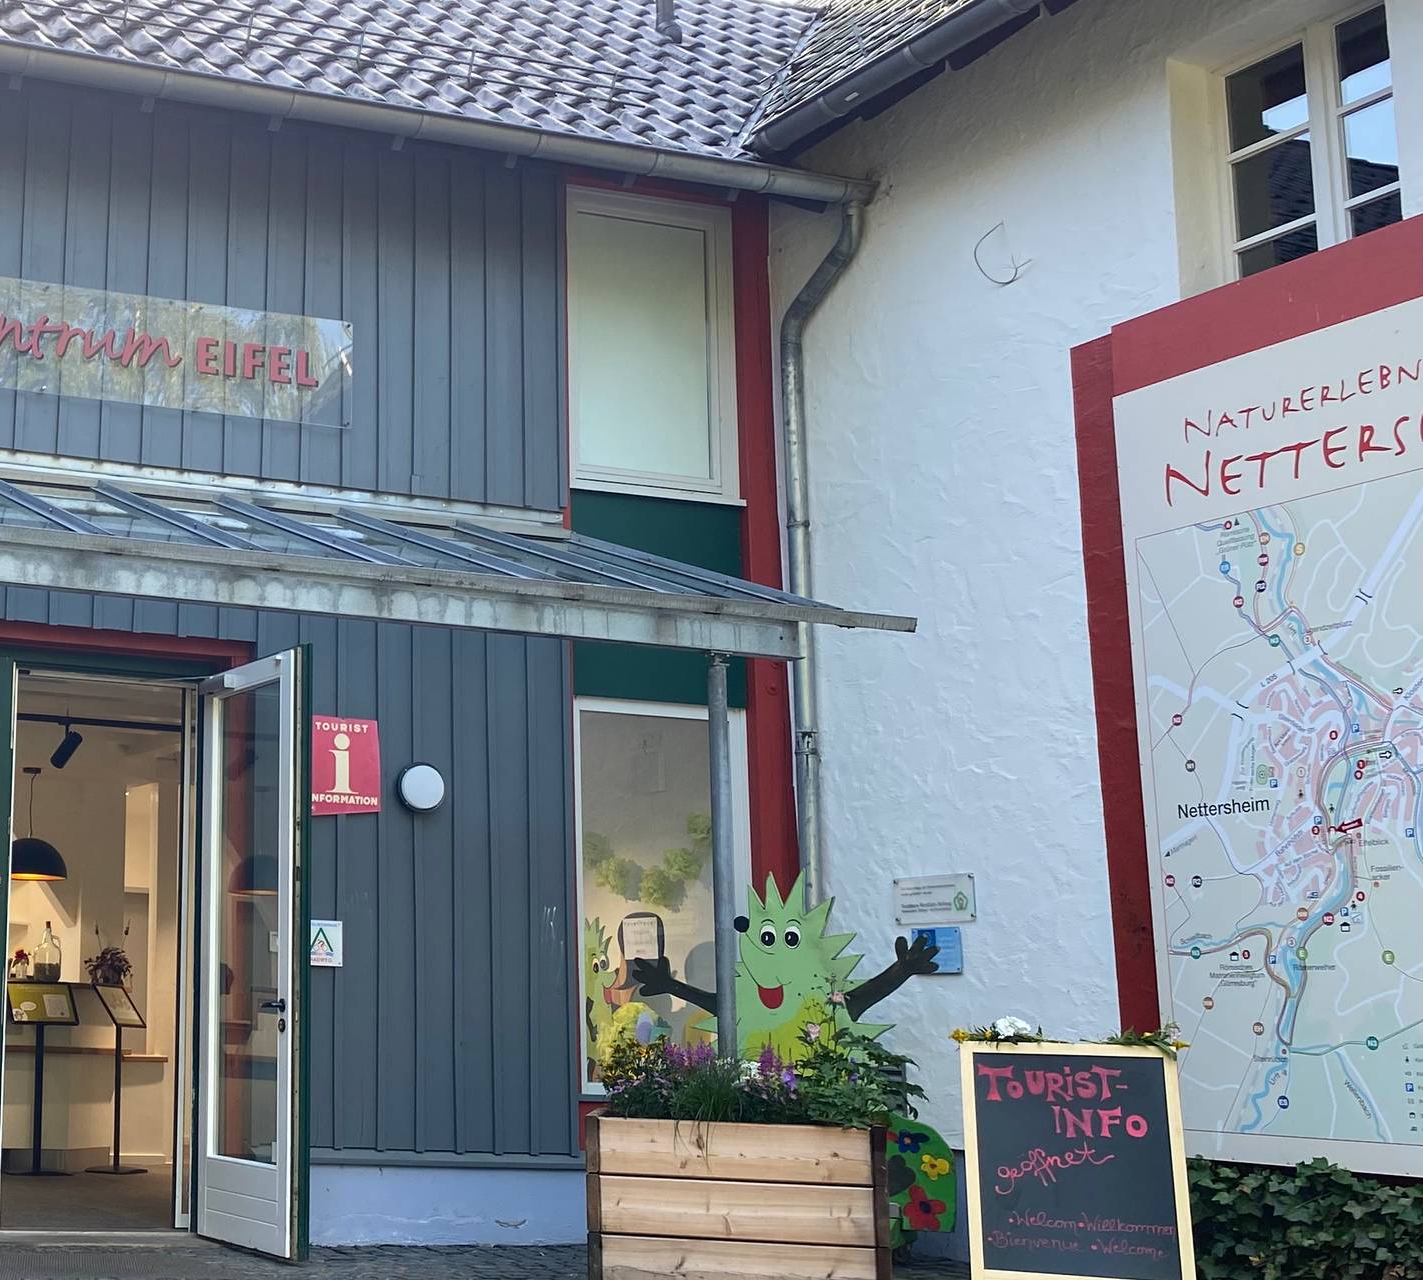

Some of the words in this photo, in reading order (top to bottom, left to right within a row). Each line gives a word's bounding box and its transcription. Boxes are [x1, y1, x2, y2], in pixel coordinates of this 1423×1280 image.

[195, 337, 319, 387] EIFEL
[315, 721, 368, 733] TOURIST
[311, 793, 378, 806] NFORMATION
[1177, 797, 1270, 819] Nettersheim
[1051, 1104, 1148, 1138] INFO
[995, 1141, 1115, 1194] geöffnet
[992, 1231, 1081, 1250] Bienvenue
[1097, 1236, 1168, 1259] Welcome
